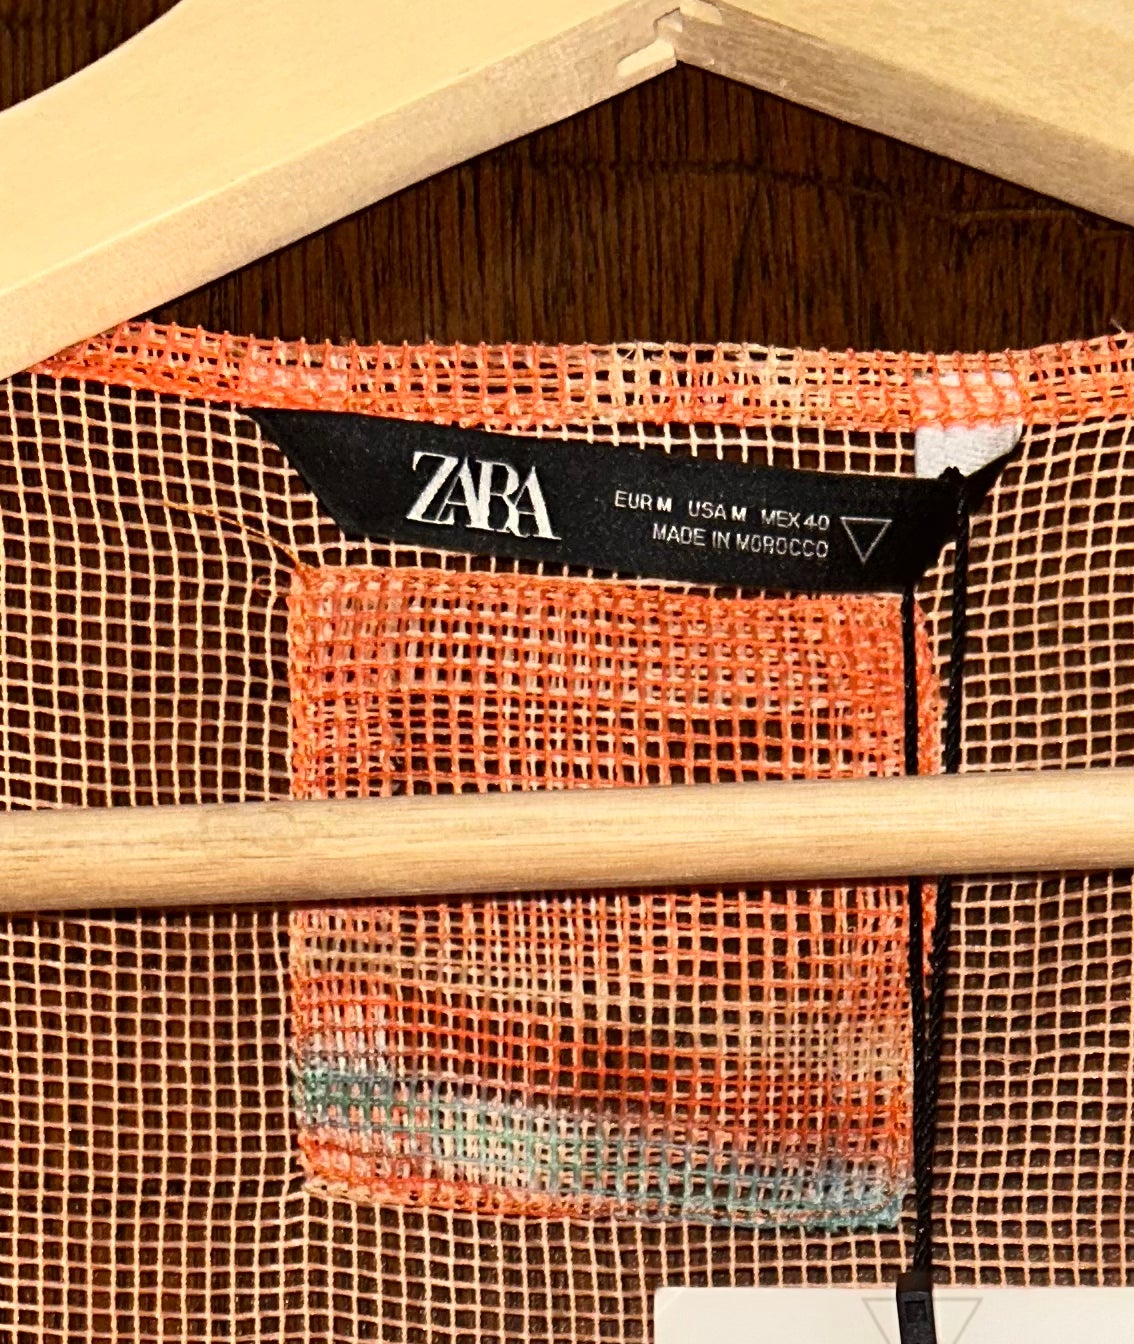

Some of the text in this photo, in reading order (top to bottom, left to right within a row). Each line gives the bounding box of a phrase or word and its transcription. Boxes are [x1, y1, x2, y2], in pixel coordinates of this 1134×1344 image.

[405, 451, 563, 541] ZARA
[614, 489, 830, 532] EUR M USA M MEX 40
[652, 522, 829, 559] MADE IN MOROCCO
